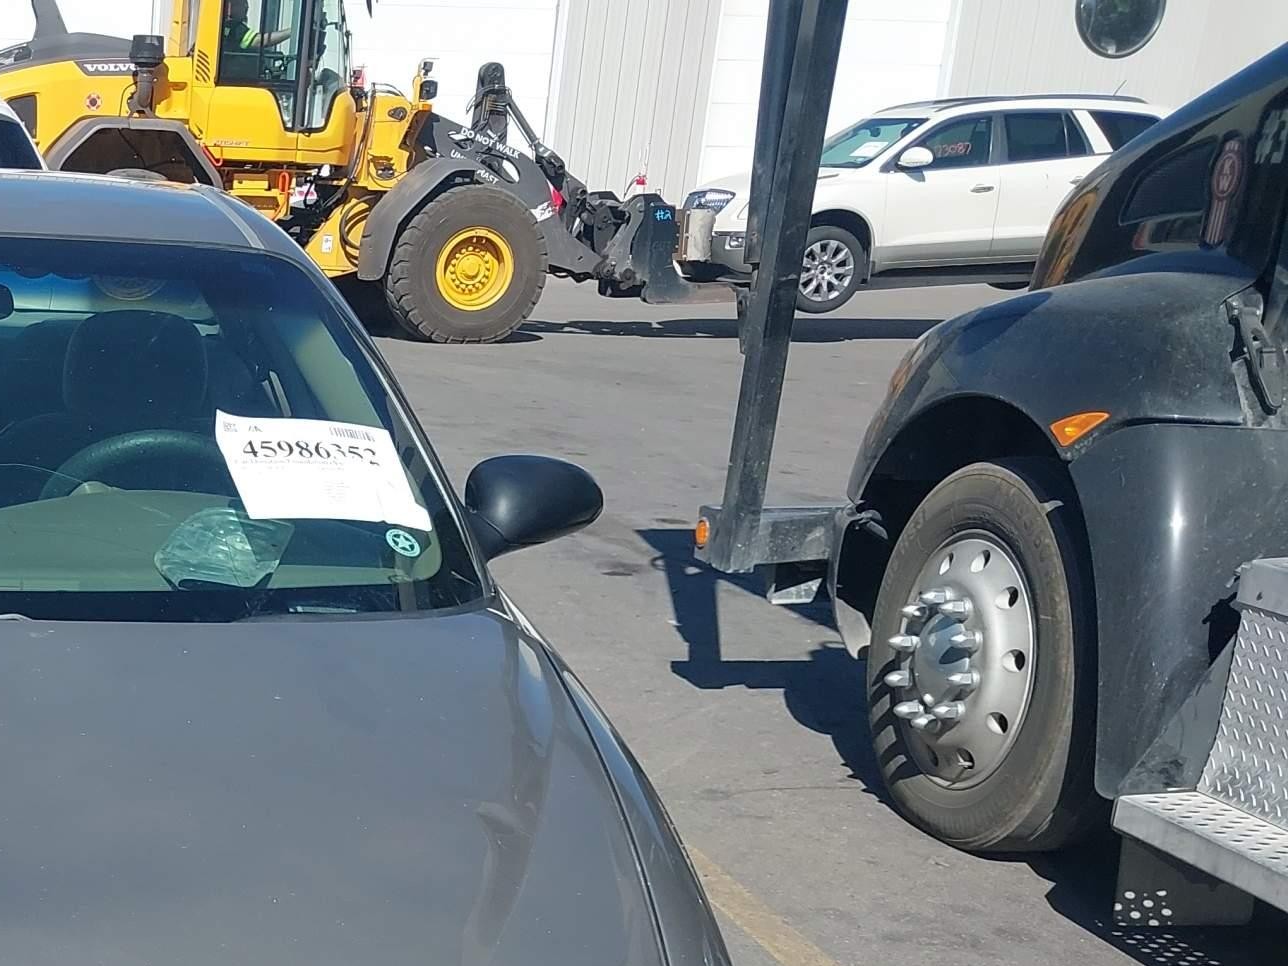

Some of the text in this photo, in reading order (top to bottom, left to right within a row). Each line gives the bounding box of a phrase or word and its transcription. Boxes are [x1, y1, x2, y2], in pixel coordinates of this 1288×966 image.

[460, 127, 520, 159] DO NOT WALK
[242, 439, 380, 466] 45986352
